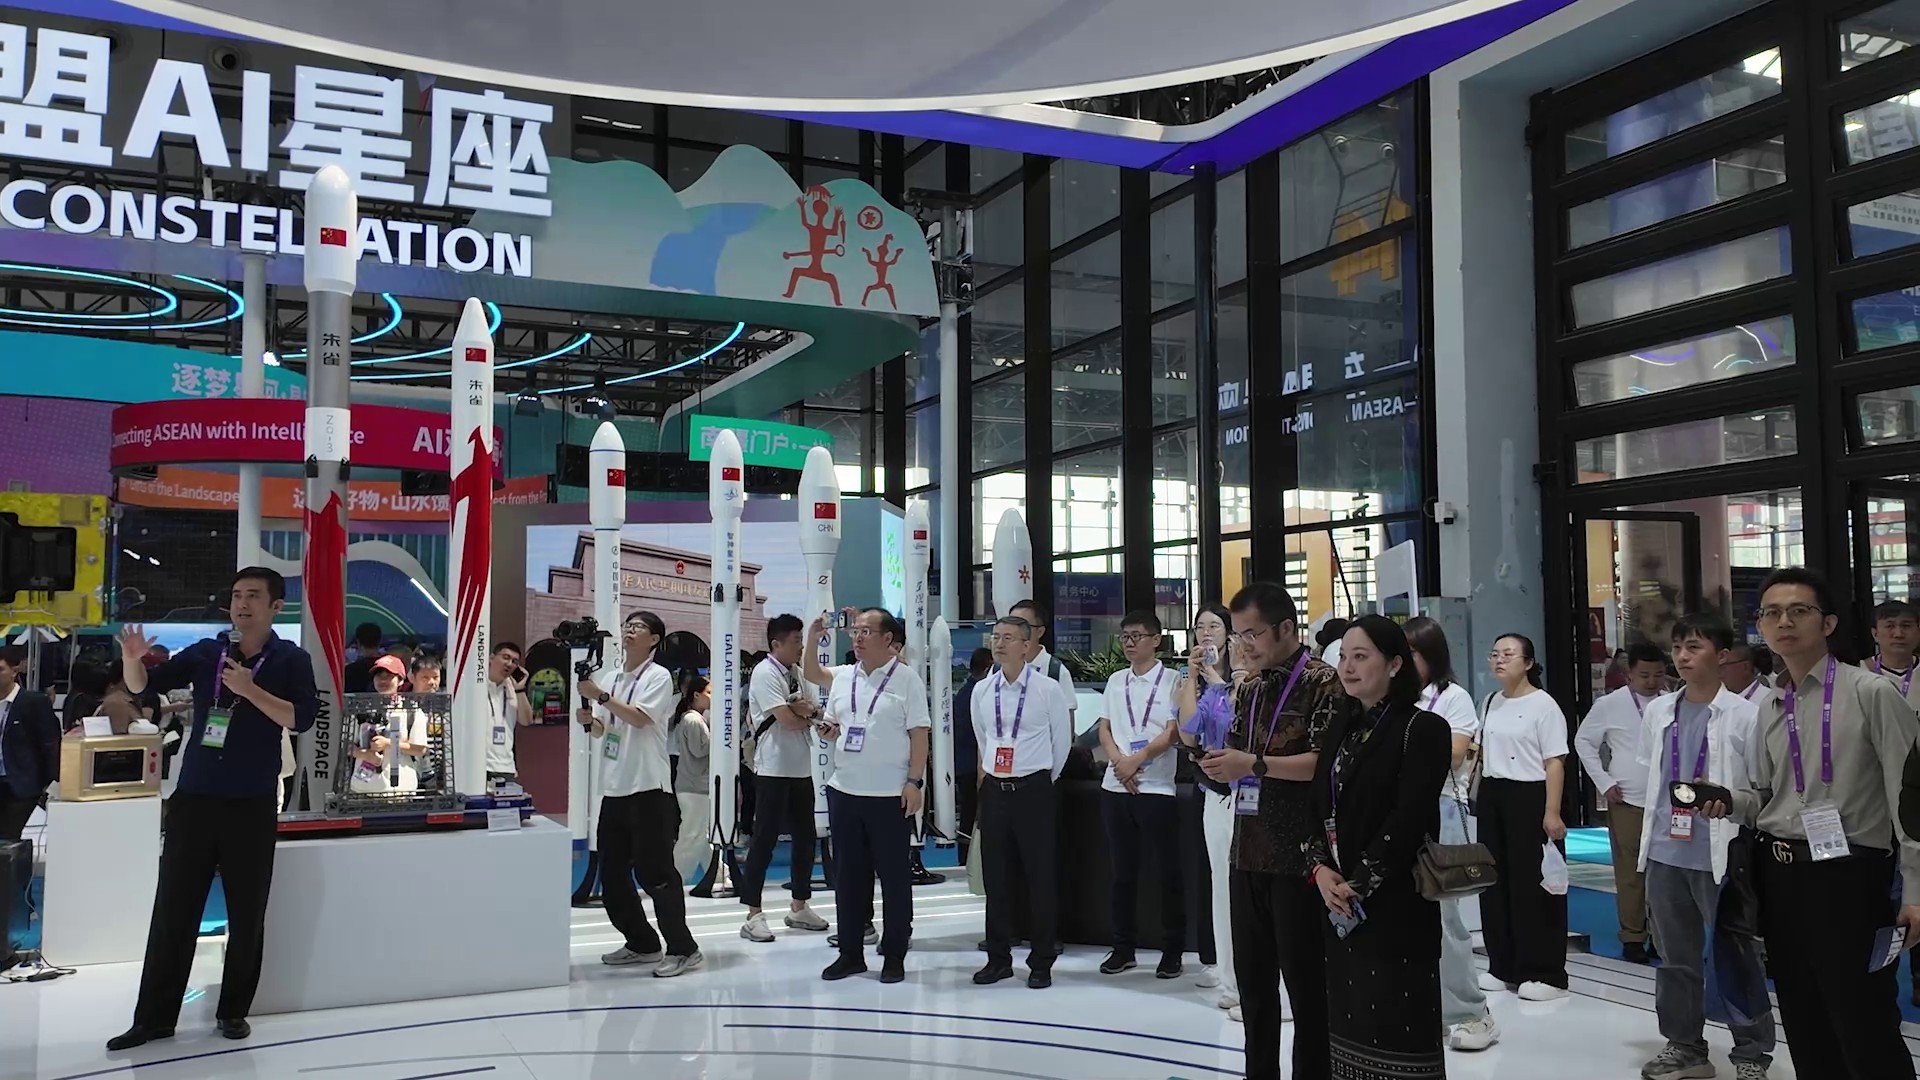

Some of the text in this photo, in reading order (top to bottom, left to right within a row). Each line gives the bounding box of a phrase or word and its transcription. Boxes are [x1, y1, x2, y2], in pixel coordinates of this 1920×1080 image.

[0, 178, 533, 278] CONSTELATION
[322, 333, 341, 367] 朱雀
[469, 379, 483, 406] 朱雀
[153, 422, 202, 441] ASEAN
[205, 420, 246, 440] with
[251, 421, 365, 445] Intellice
[174, 483, 240, 505] Landscape
[817, 523, 834, 533] CHN
[1058, 585, 1100, 598] 商务中心
[476, 624, 485, 684] LANDSPACE
[724, 633, 733, 750] GALACTIC ENERGY
[314, 689, 331, 780] LANDSPACE
